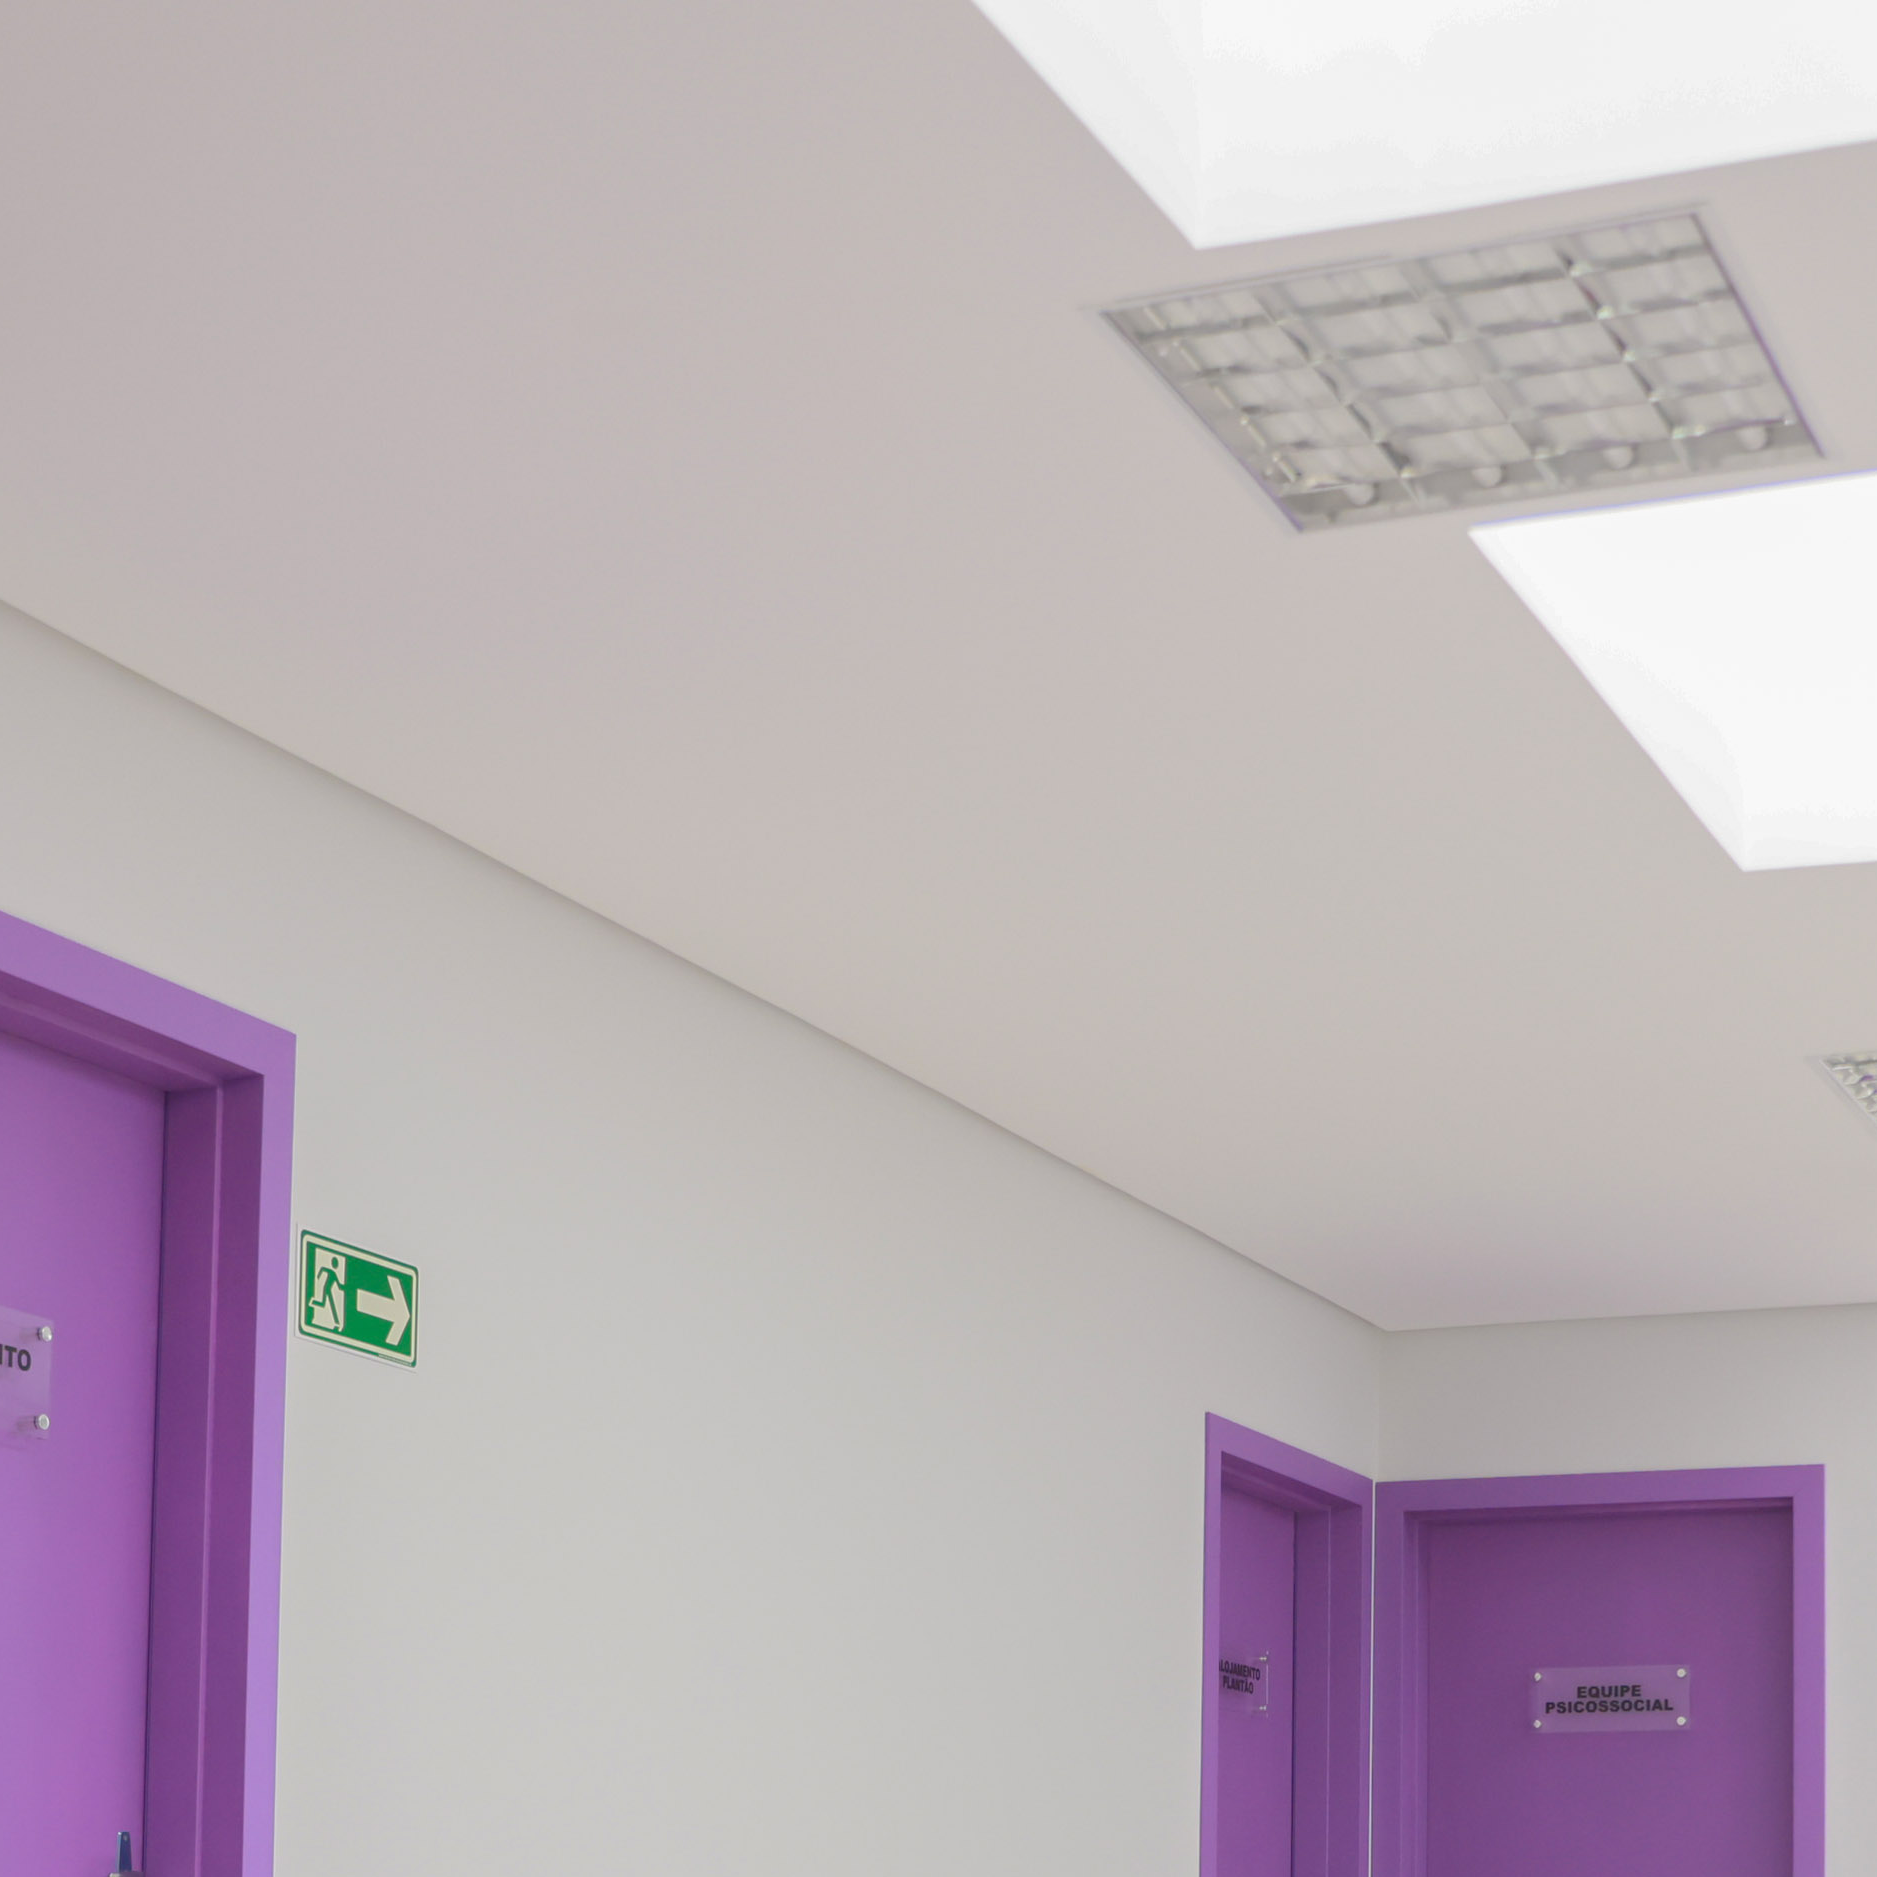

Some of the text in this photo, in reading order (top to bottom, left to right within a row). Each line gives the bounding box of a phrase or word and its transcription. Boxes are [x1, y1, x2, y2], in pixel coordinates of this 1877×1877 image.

[1219, 1659, 1260, 1680] LOJAMENTO
[1576, 1684, 1642, 1699] EQUIPE
[1545, 1699, 1674, 1714] PSICOSSOCIAL
